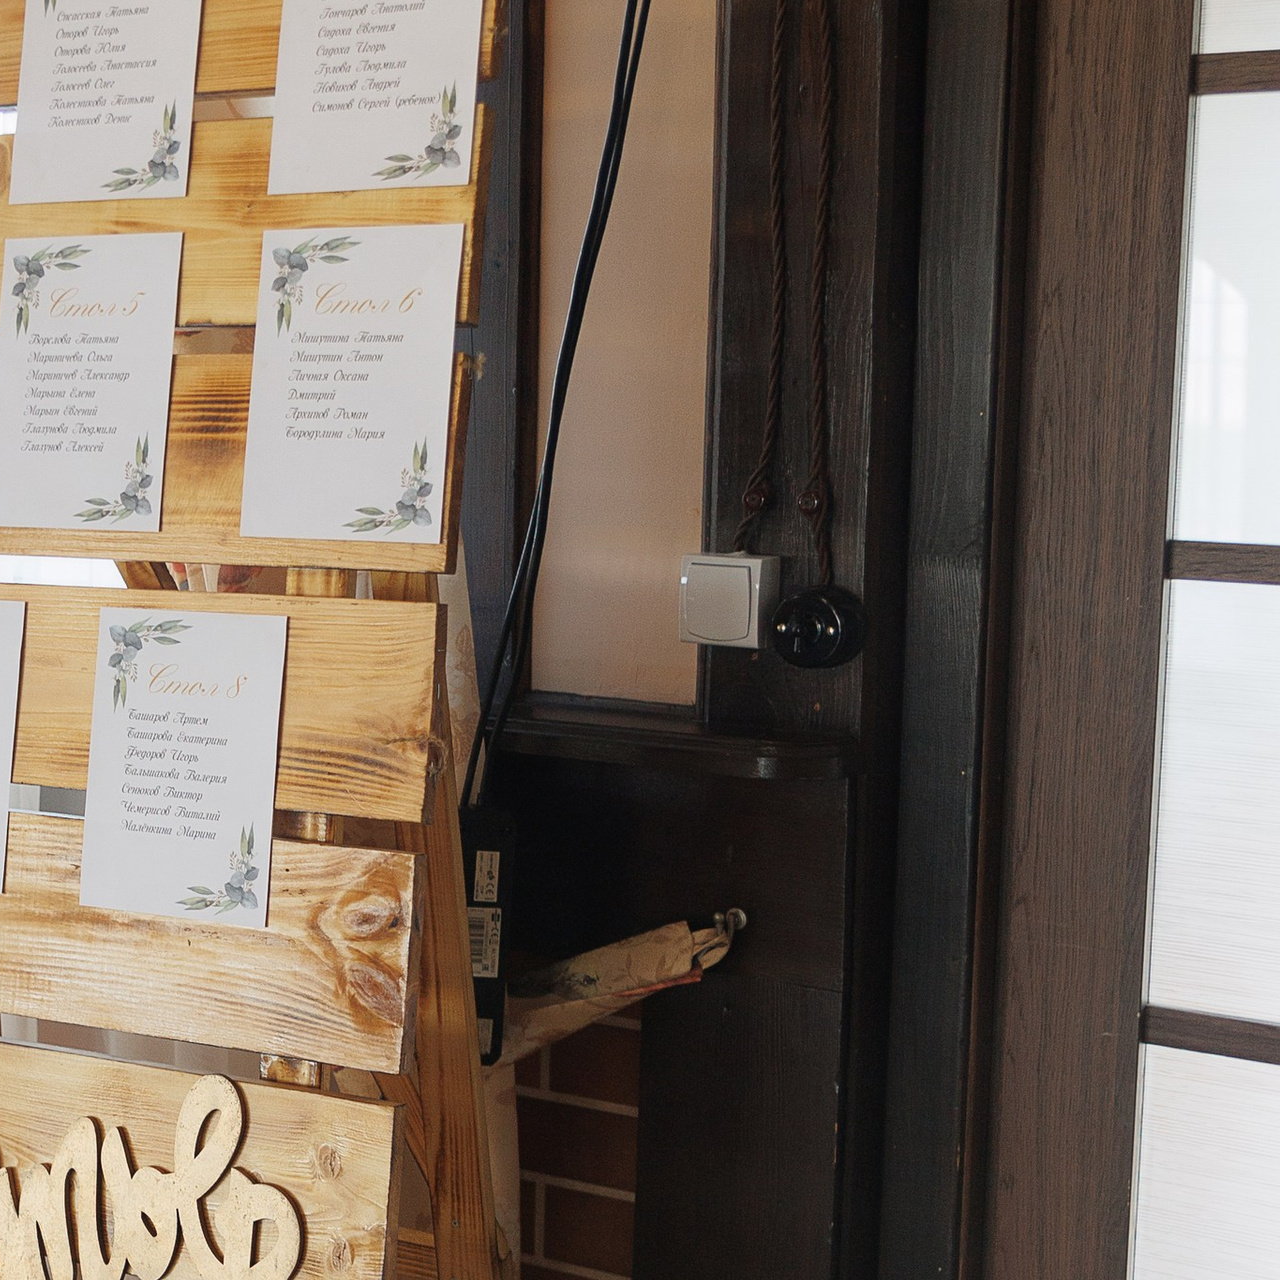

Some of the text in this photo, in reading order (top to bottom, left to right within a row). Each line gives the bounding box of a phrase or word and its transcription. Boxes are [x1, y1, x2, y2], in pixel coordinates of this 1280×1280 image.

[56, 5, 150, 22] Спасская Татьяна
[319, 4, 367, 19] Гончаров
[93, 25, 119, 38] Игорь
[317, 22, 396, 40] Садоха Евгения
[95, 42, 126, 54] Юлия
[316, 41, 386, 58] Садоха Игорь
[355, 59, 407, 73] Людмила
[94, 78, 115, 89] Олег
[313, 77, 401, 95] Новиков Андрей
[111, 95, 155, 106] Татьяна
[312, 93, 441, 113] Симонов Сергей (ребенок)
[104, 113, 132, 125] Денис
[50, 288, 146, 318] Стол 5
[313, 282, 423, 316] Стол 6
[75, 332, 119, 344] Татьяна
[291, 331, 404, 347] Мишутина Татьяна
[87, 351, 113, 362] Ольга
[289, 350, 384, 365] Мишутин Антон
[80, 369, 130, 383] Александр
[288, 370, 369, 382] Личная Оксана
[70, 387, 96, 398] Елена
[287, 389, 336, 403] Дмитрий
[63, 405, 97, 417] Евгений
[285, 407, 369, 422] Архипов Роман
[22, 422, 117, 436] Глазунова Людмила
[285, 426, 386, 442] Бородулина Мария
[21, 440, 104, 453] Глазунов Алексей
[148, 663, 248, 699] Стол 8
[128, 708, 209, 726] Башаров Артем
[126, 727, 228, 747] Башарова Екатерина
[124, 745, 199, 763] Федоров Игорь
[184, 769, 227, 784] Валерия
[163, 786, 203, 802] Виктор
[120, 800, 221, 822] Чемерисов Виталий
[176, 825, 217, 840] Марина
